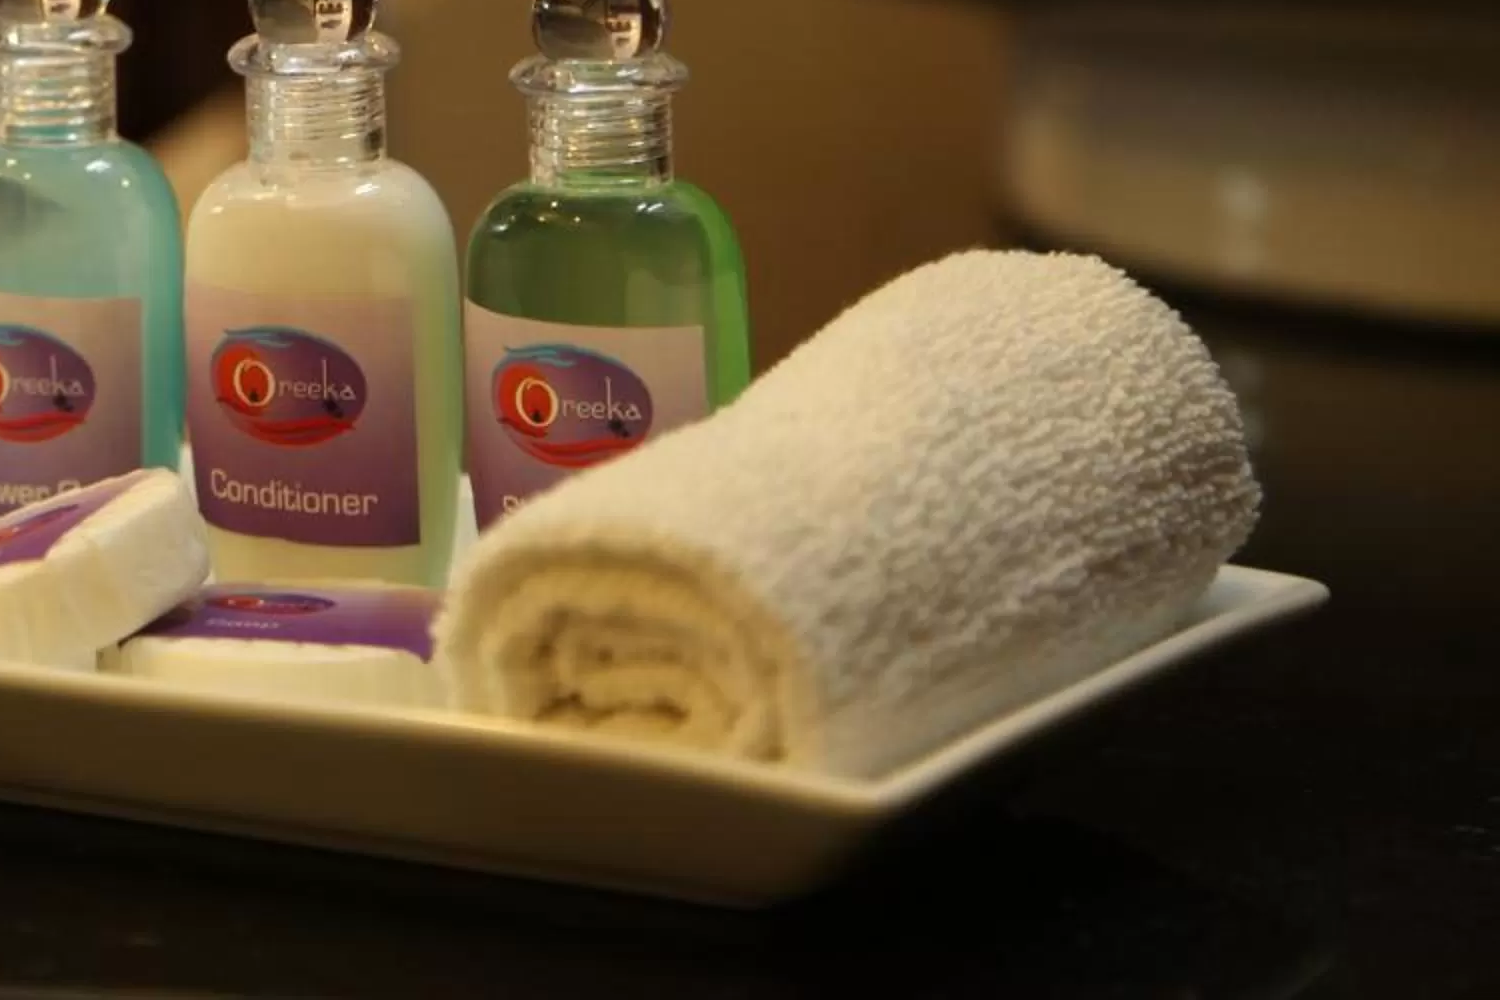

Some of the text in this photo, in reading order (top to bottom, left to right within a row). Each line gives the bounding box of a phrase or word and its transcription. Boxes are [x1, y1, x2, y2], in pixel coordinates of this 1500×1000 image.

[233, 357, 356, 407] Oreeka
[515, 376, 642, 427] Oreeka
[211, 468, 378, 516] Conditioner
